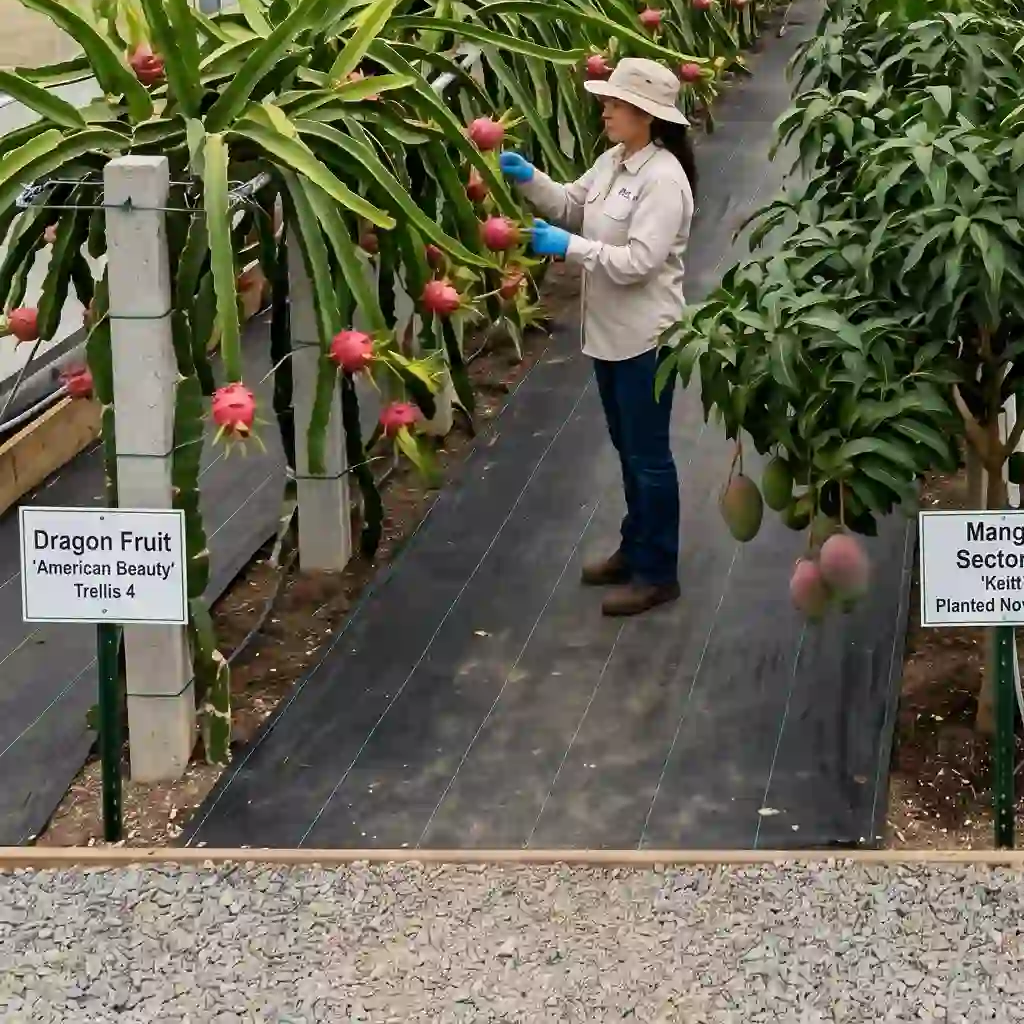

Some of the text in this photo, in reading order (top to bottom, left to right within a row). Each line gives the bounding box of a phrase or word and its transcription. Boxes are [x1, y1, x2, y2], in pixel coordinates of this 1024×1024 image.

[34, 529, 172, 556] Dragon Fruit
[33, 559, 175, 581] 'American Beauty'
[74, 583, 136, 599] Trellis 4
[936, 597, 995, 613] Planted
